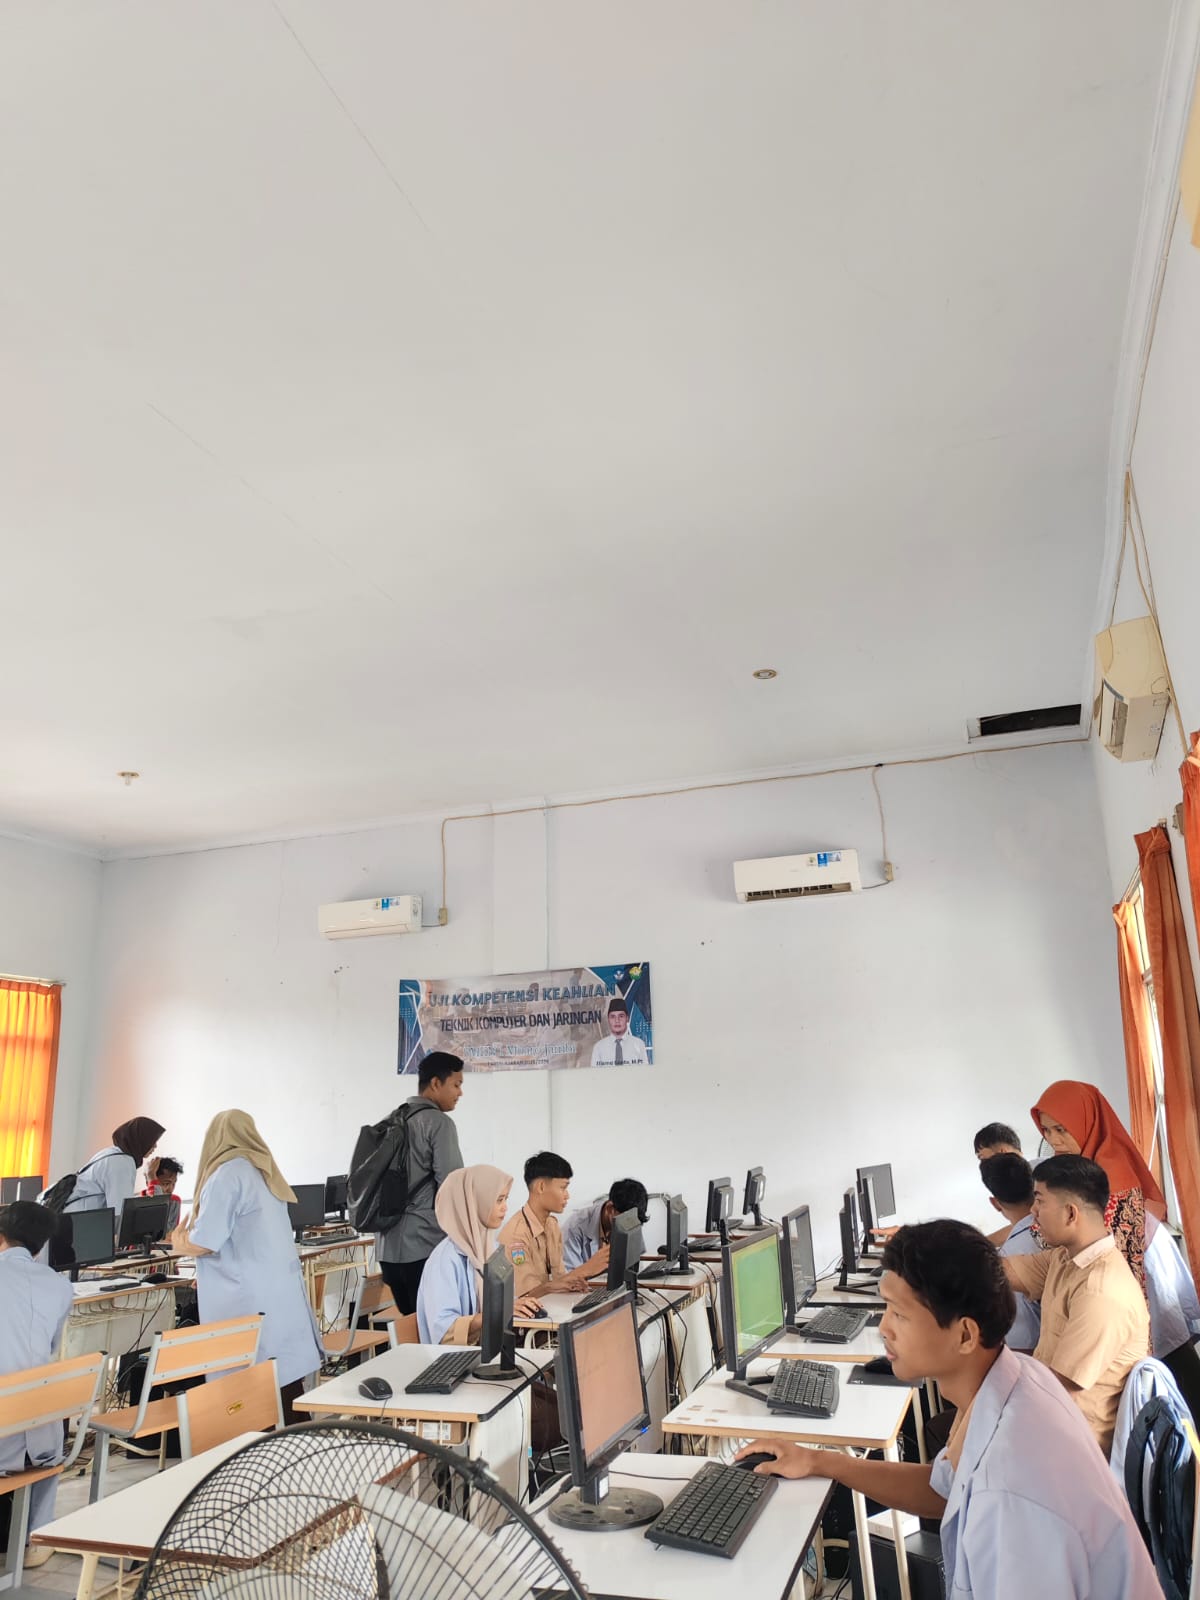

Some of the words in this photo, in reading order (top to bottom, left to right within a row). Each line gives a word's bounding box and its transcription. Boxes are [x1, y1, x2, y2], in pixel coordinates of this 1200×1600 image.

[430, 993, 449, 1007] UJI
[452, 990, 539, 1006] KOMPETENSI
[542, 983, 616, 1001] KEAHLIAN
[440, 1018, 474, 1032] TEKNIK
[476, 1015, 527, 1030] KOMPUTER
[529, 1013, 550, 1027] DAN
[551, 1010, 602, 1029] JARINGAN
